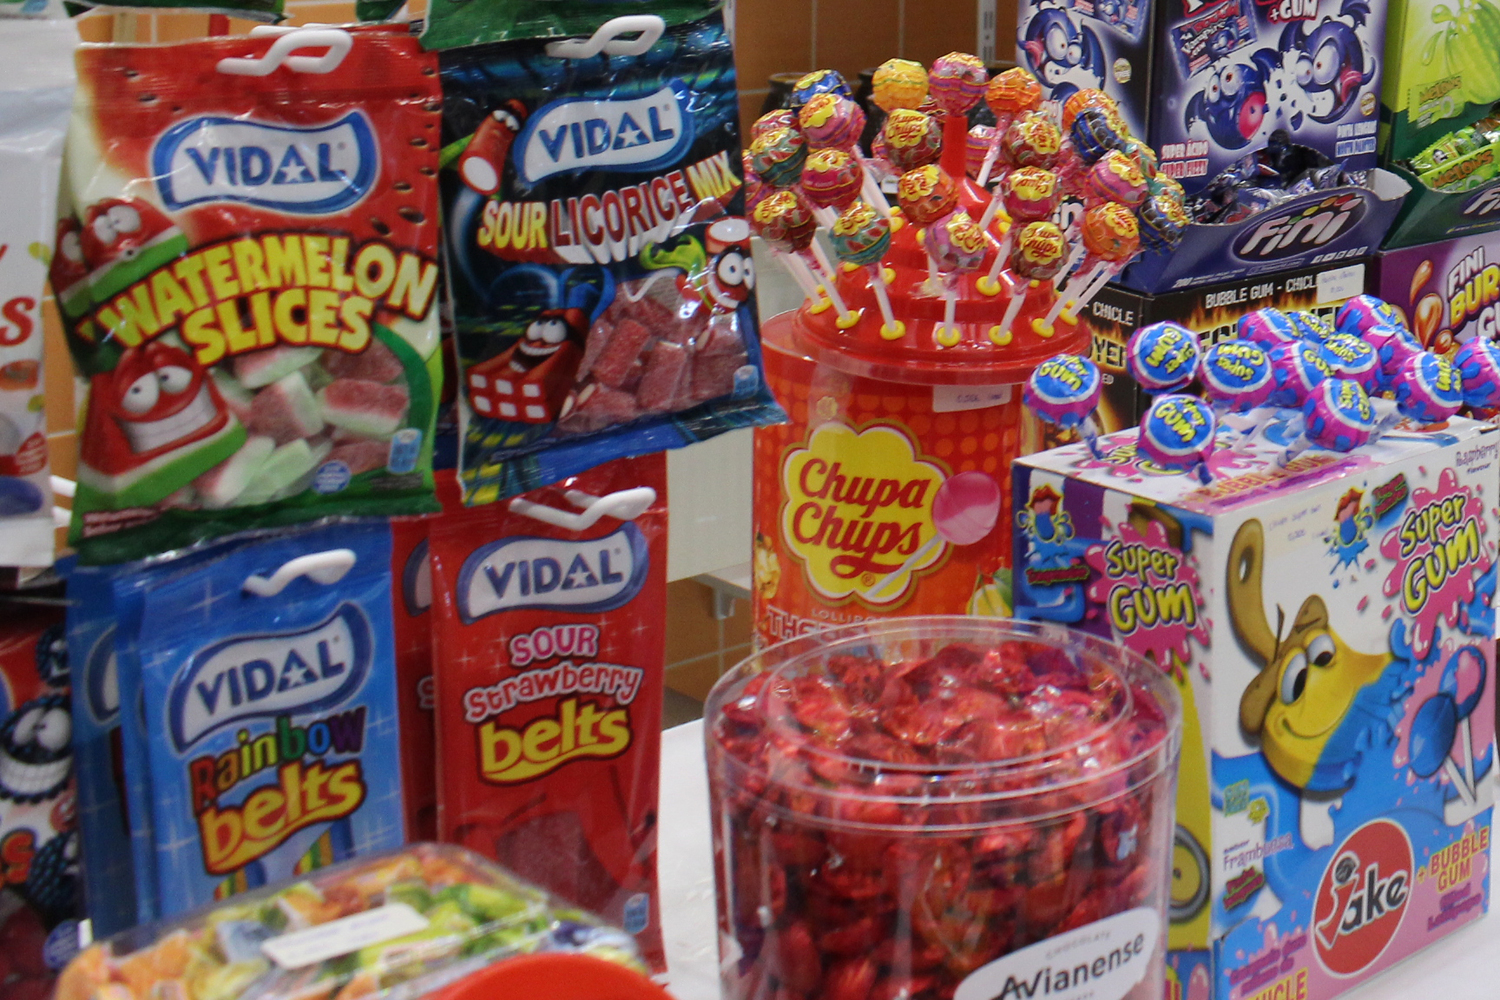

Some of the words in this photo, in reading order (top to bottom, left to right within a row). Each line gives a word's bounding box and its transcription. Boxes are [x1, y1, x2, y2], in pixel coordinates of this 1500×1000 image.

[186, 139, 347, 187] VIDAL
[536, 104, 678, 164] VIDAL
[477, 197, 549, 250] SOUR
[550, 168, 696, 262] LICORICE
[685, 149, 743, 202] MIX
[1239, 194, 1364, 256] Fini
[97, 235, 440, 349] WATERMELON
[1205, 287, 1248, 310] BUBBLE
[1249, 282, 1275, 302] GUM
[1285, 274, 1319, 294] CHICL
[1447, 245, 1486, 294] FINI
[182, 285, 374, 366] SLICES
[1092, 300, 1135, 327] CHICLE
[798, 458, 933, 520] Chupa
[792, 500, 925, 580] Chups
[1399, 493, 1468, 558] Super
[483, 548, 624, 600] VIDAL
[1104, 539, 1179, 583] Super
[1402, 516, 1481, 616] GUM
[1109, 582, 1197, 634] GUM
[195, 638, 347, 716] VIDAL
[510, 624, 600, 668] SOUR
[463, 660, 645, 723] Strawberry
[478, 697, 631, 783] belts
[199, 757, 367, 878] belts
[1429, 825, 1491, 877] BUBBLE
[1436, 857, 1474, 895] GUM
[1316, 850, 1410, 950] Jake
[990, 932, 1145, 1000] Avianense
